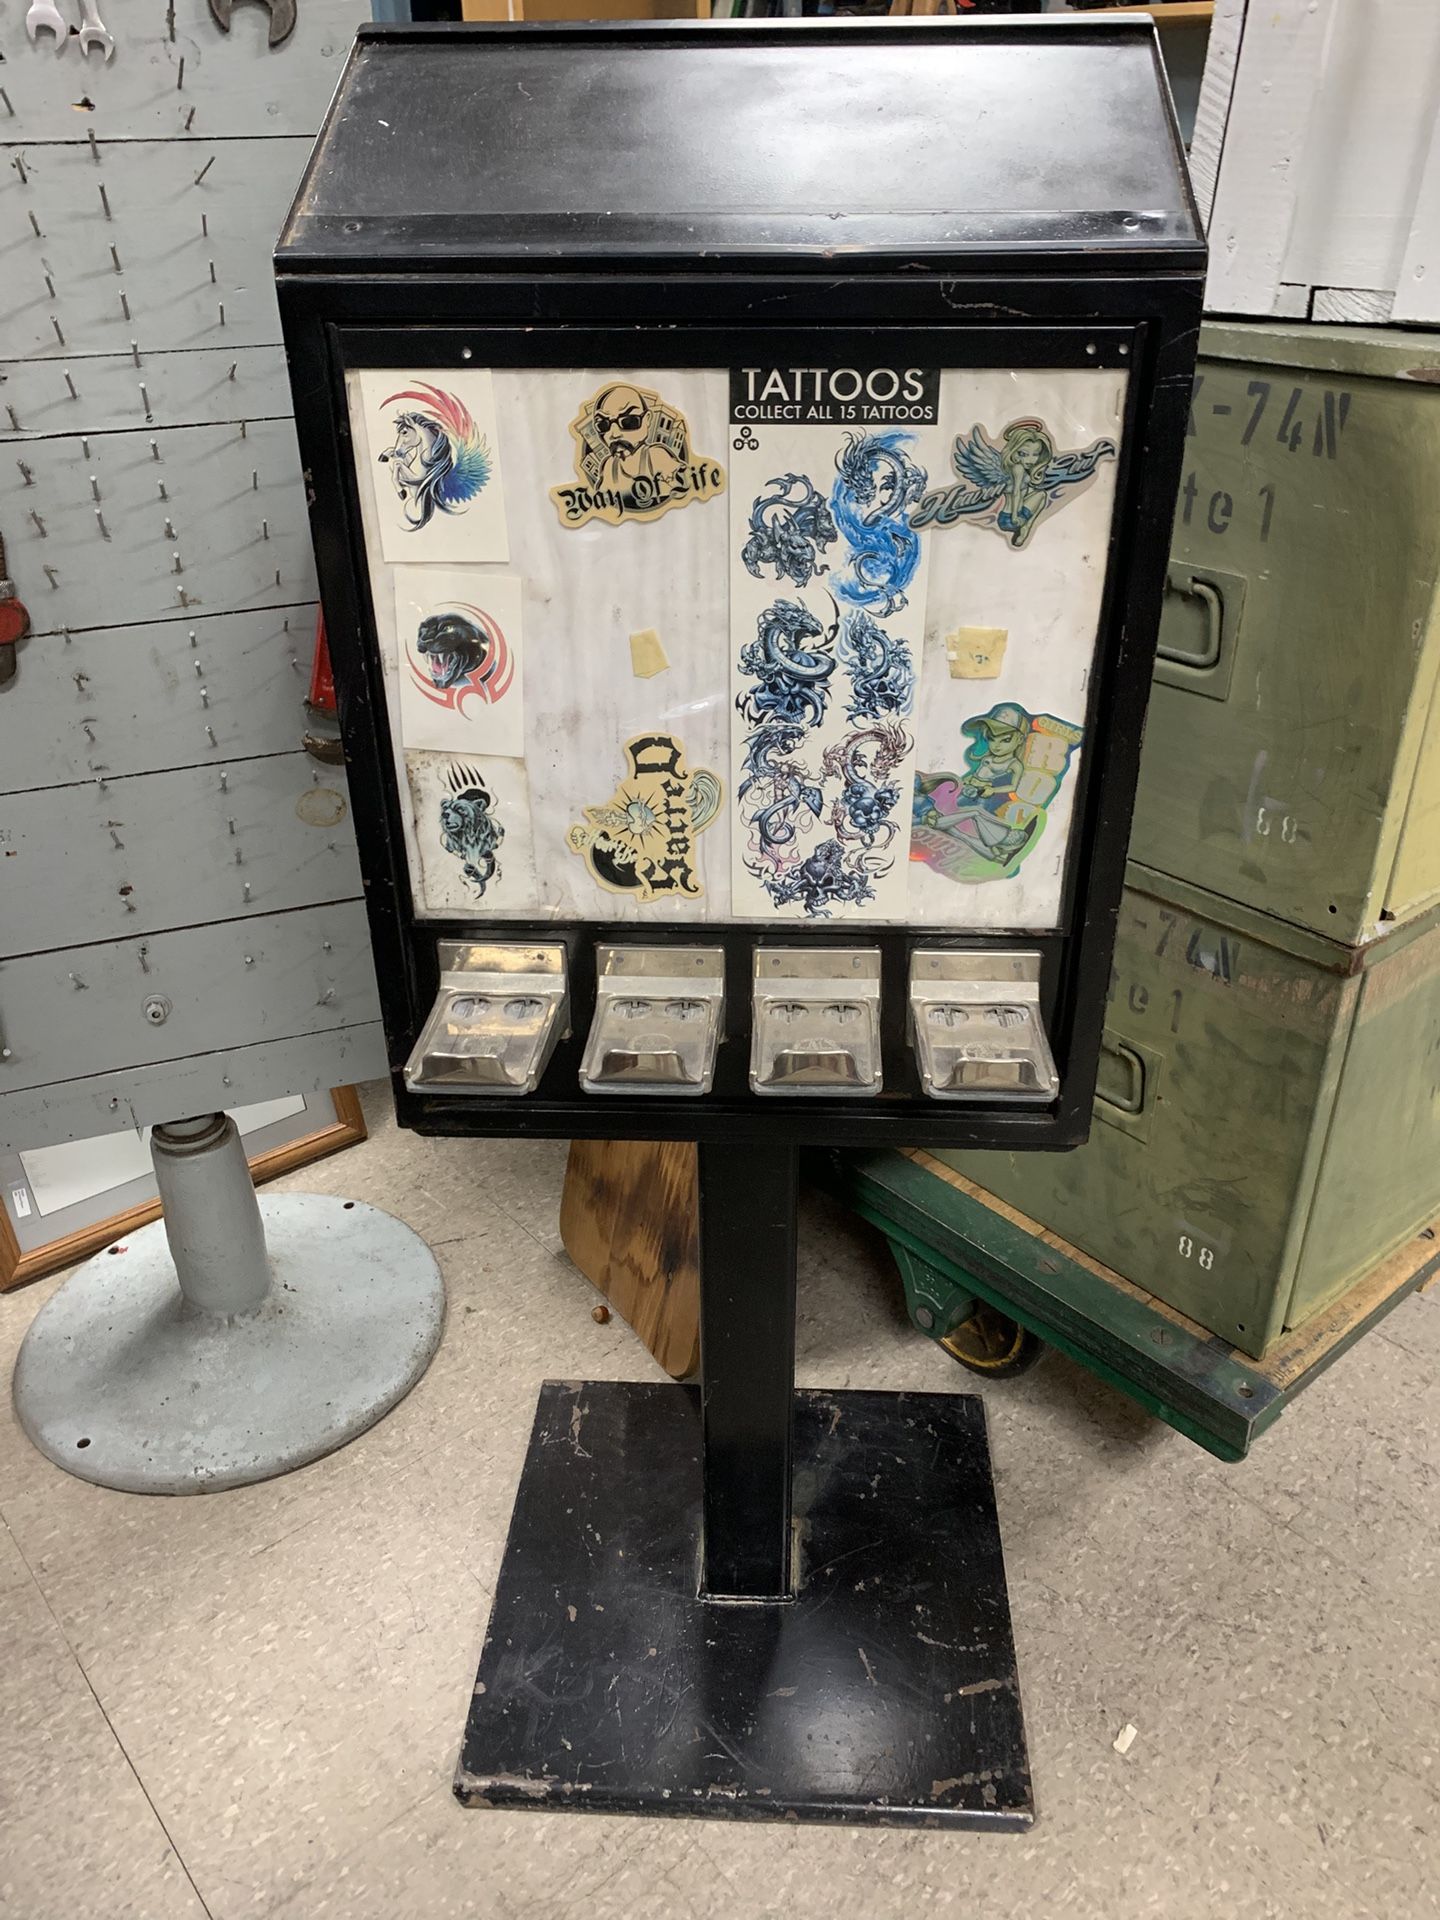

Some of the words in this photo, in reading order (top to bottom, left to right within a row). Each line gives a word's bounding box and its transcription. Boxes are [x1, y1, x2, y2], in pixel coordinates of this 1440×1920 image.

[742, 368, 924, 402] TATTOOS
[734, 405, 802, 420] COLLECT
[806, 405, 833, 420] ALL
[840, 405, 856, 420] 15
[861, 405, 934, 420] TATTOOS
[557, 486, 624, 520] Way
[631, 472, 662, 504] Of
[670, 463, 721, 498] Life
[1179, 1235, 1214, 1271] 88
